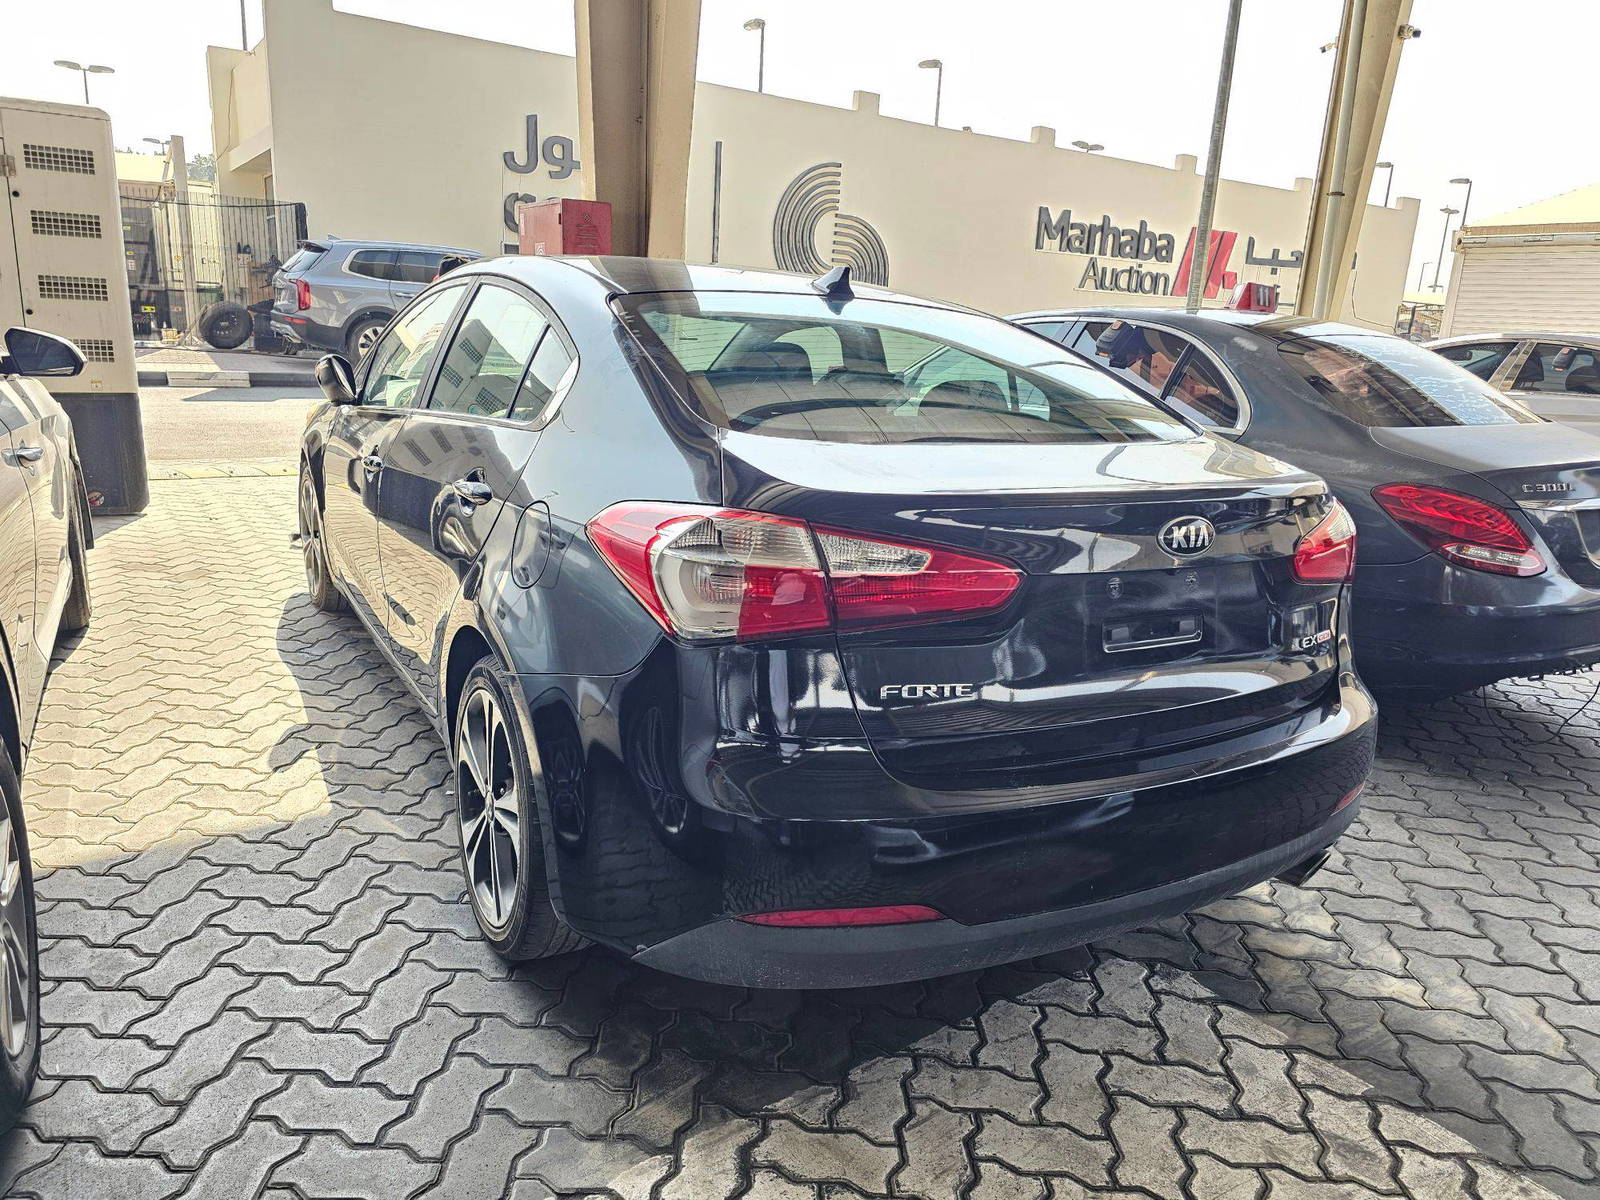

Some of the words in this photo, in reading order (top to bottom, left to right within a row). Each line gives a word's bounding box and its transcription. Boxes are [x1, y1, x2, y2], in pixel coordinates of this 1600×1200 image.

[1035, 205, 1175, 263] Marhaba
[1078, 257, 1170, 296] Auction
[1172, 525, 1209, 548] KIA
[1302, 634, 1317, 648] EX
[880, 683, 974, 700] FORTE
